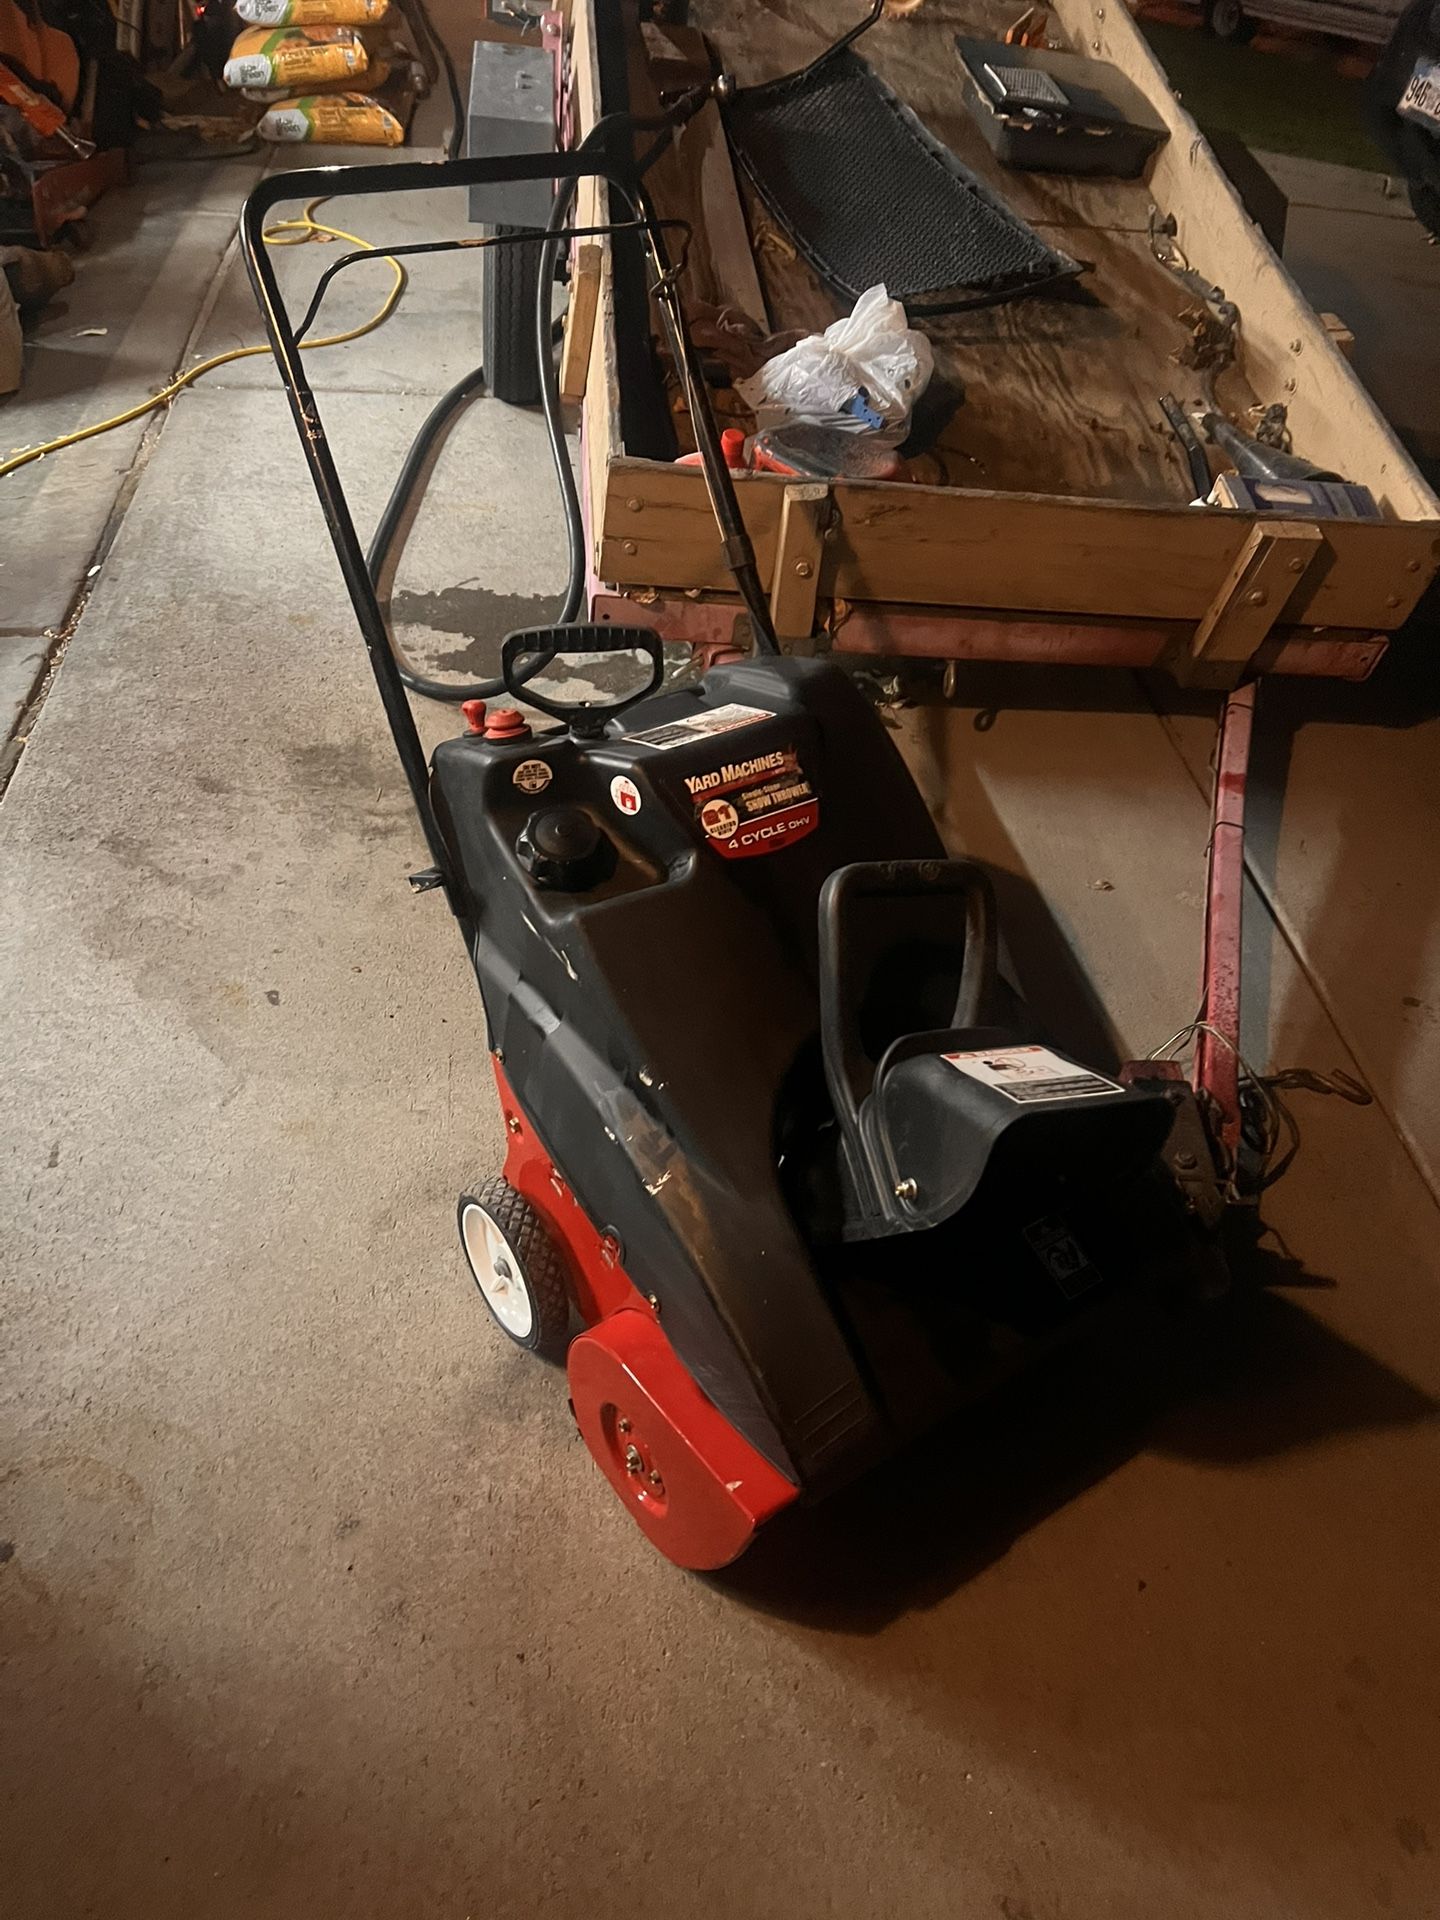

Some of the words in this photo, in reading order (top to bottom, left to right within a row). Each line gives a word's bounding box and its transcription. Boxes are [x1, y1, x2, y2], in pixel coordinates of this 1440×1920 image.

[684, 771, 721, 794] YARD
[721, 751, 785, 783] MACHINES
[728, 839, 739, 849] 4
[741, 822, 787, 846] CYCLE
[788, 815, 811, 830] OHV
